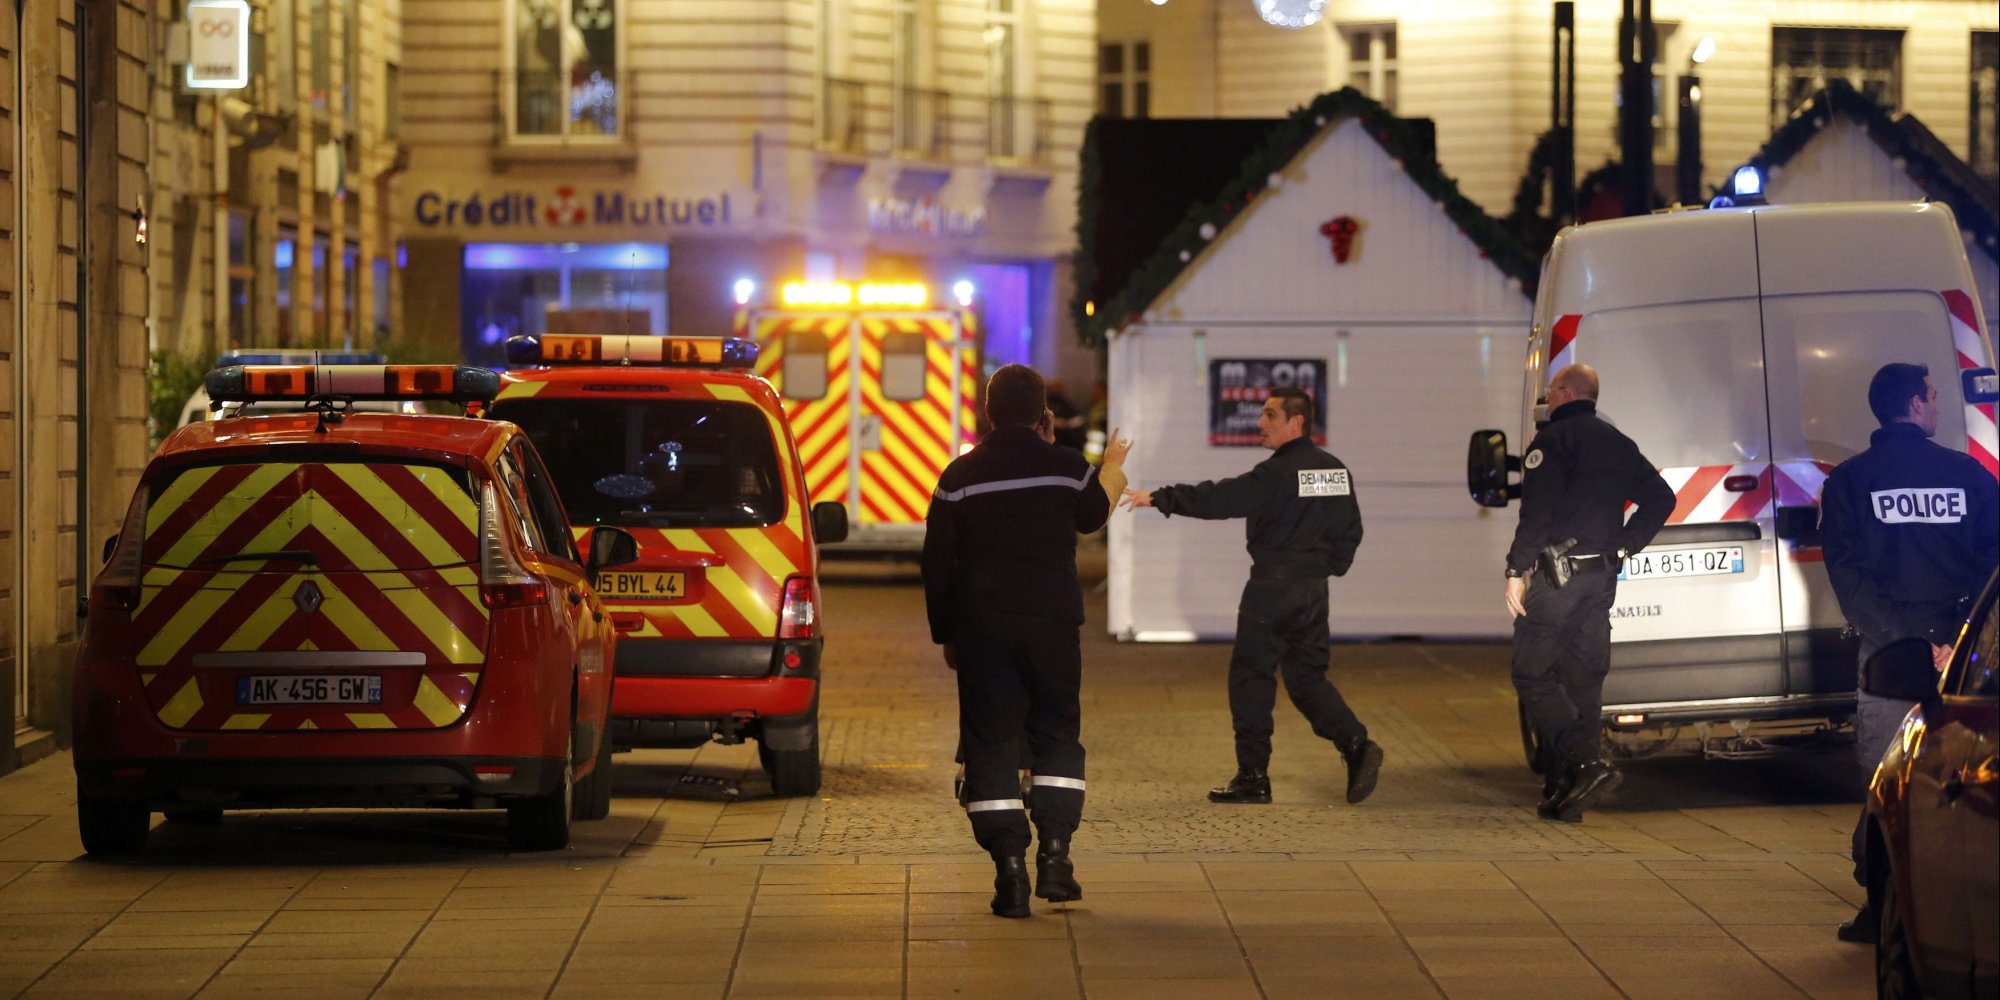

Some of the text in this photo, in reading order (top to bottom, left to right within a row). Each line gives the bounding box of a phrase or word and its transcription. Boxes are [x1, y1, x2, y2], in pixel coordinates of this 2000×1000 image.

[415, 190, 731, 226] Crédit Mutuel
[1878, 493, 1961, 519] POLICE
[618, 574, 650, 593] BYL
[655, 575, 677, 594] 44
